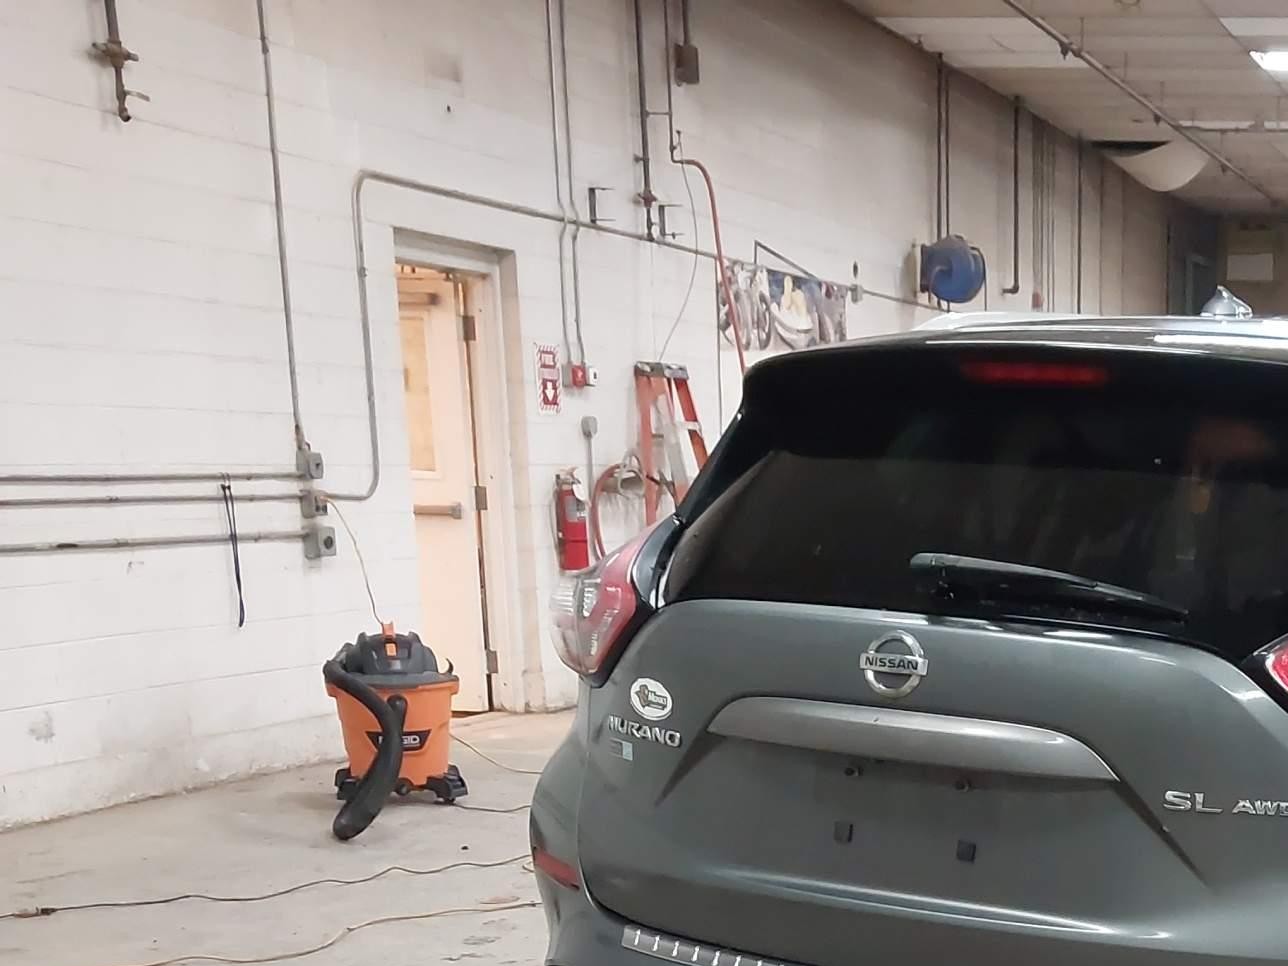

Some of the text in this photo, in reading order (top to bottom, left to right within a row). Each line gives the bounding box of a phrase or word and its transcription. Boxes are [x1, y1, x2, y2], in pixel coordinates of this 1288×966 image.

[864, 656, 919, 671] NISSAN
[608, 715, 682, 748] MURANO
[1163, 790, 1223, 814] SL
